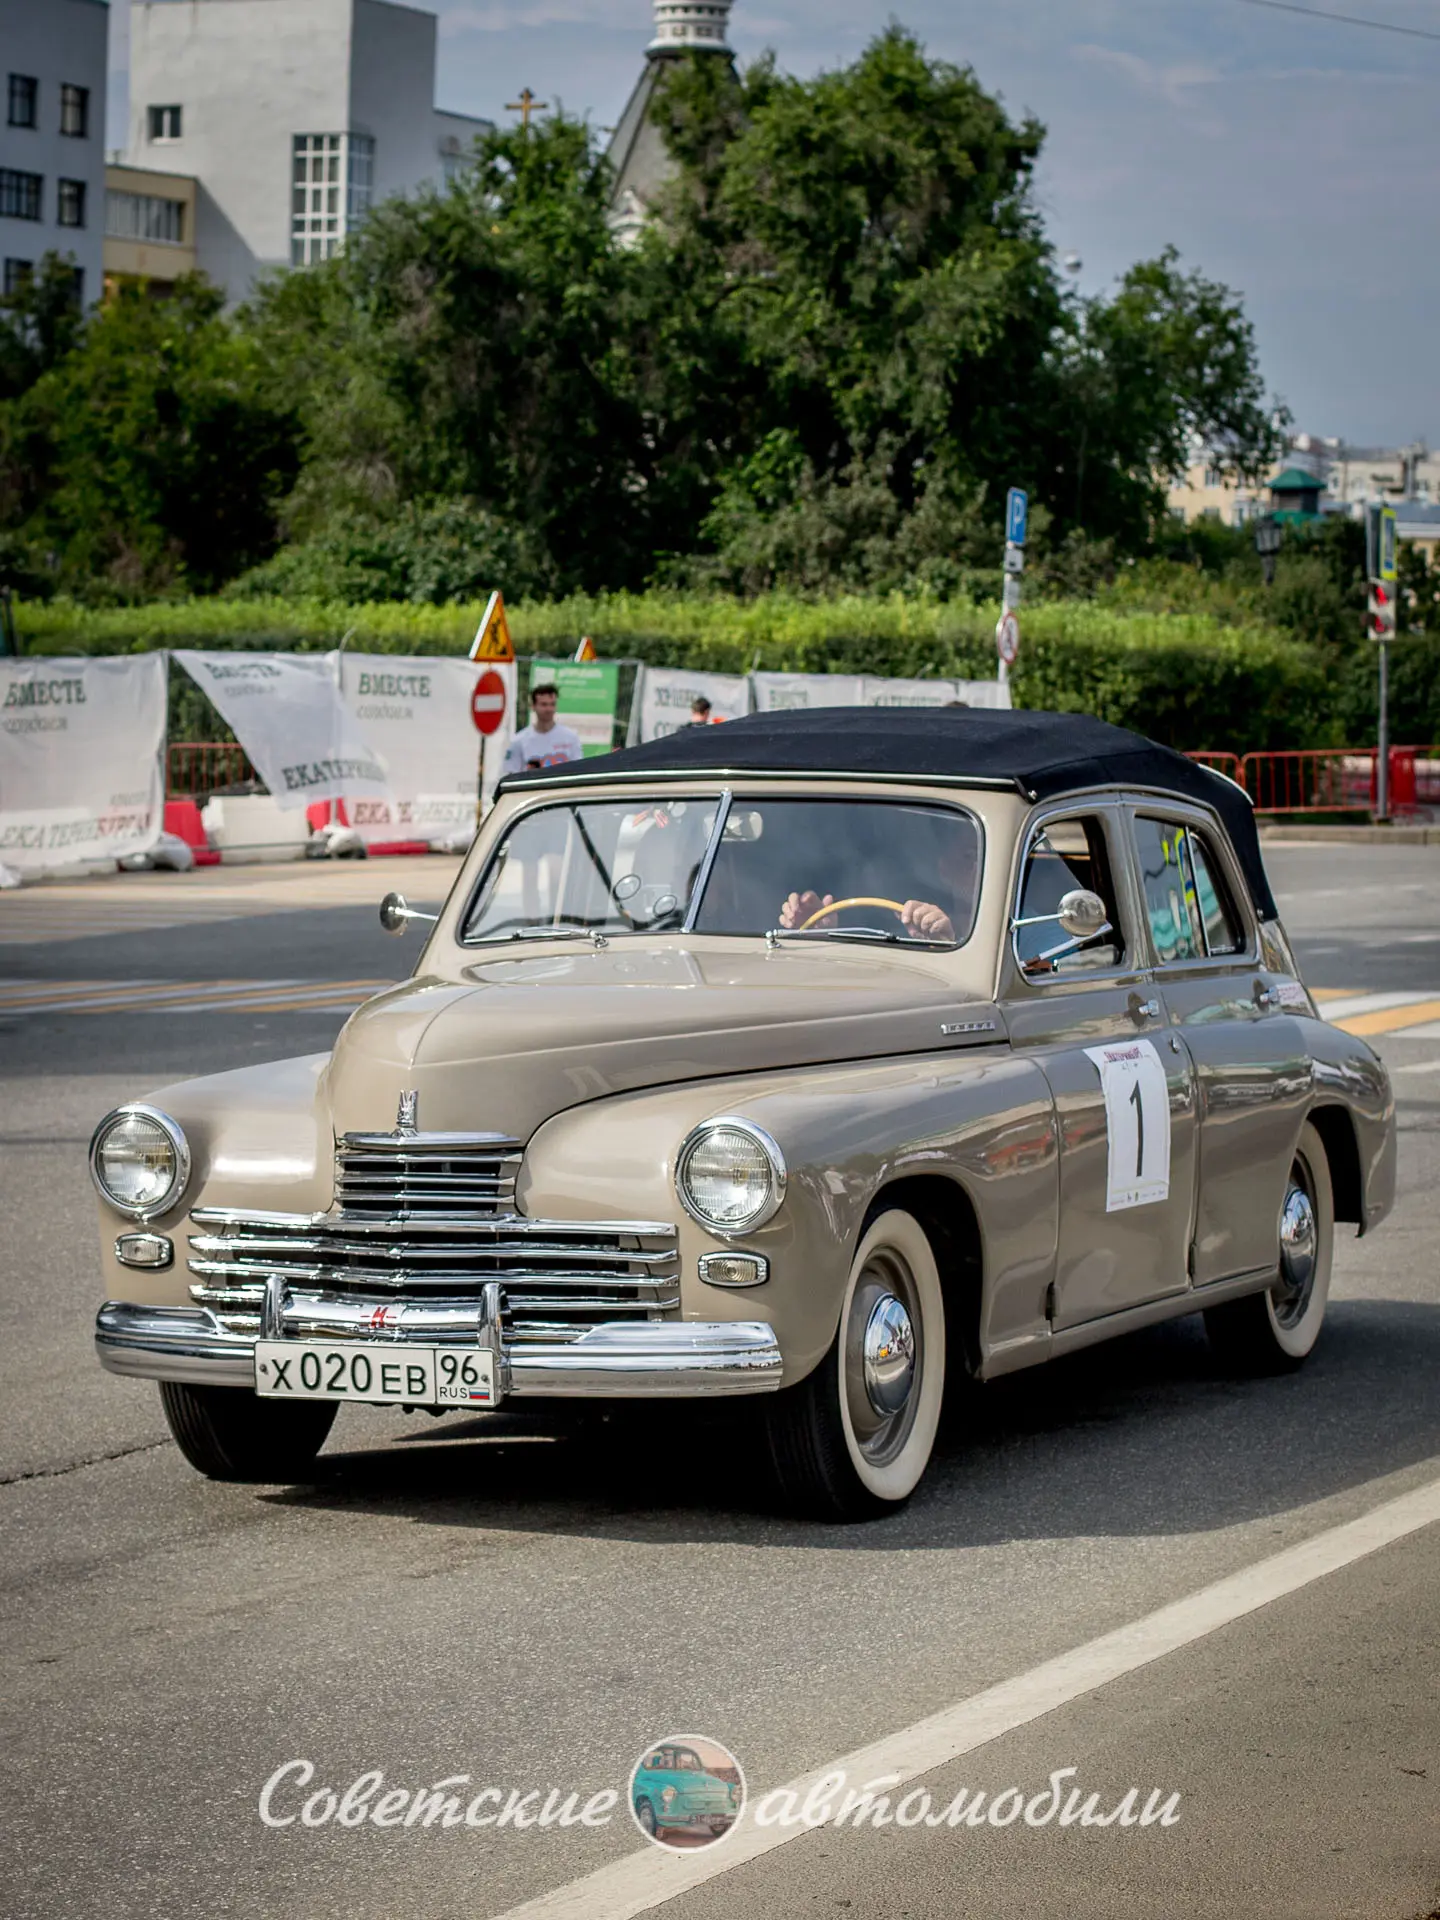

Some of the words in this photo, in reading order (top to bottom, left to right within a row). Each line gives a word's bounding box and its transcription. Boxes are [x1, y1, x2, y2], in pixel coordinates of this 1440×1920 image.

[358, 672, 432, 698] ВМЕСТЕ
[1129, 1079, 1145, 1178] 1
[271, 1352, 427, 1396] Х020ЕВ
[440, 1354, 478, 1386] 96
[439, 1386, 468, 1399] RUS
